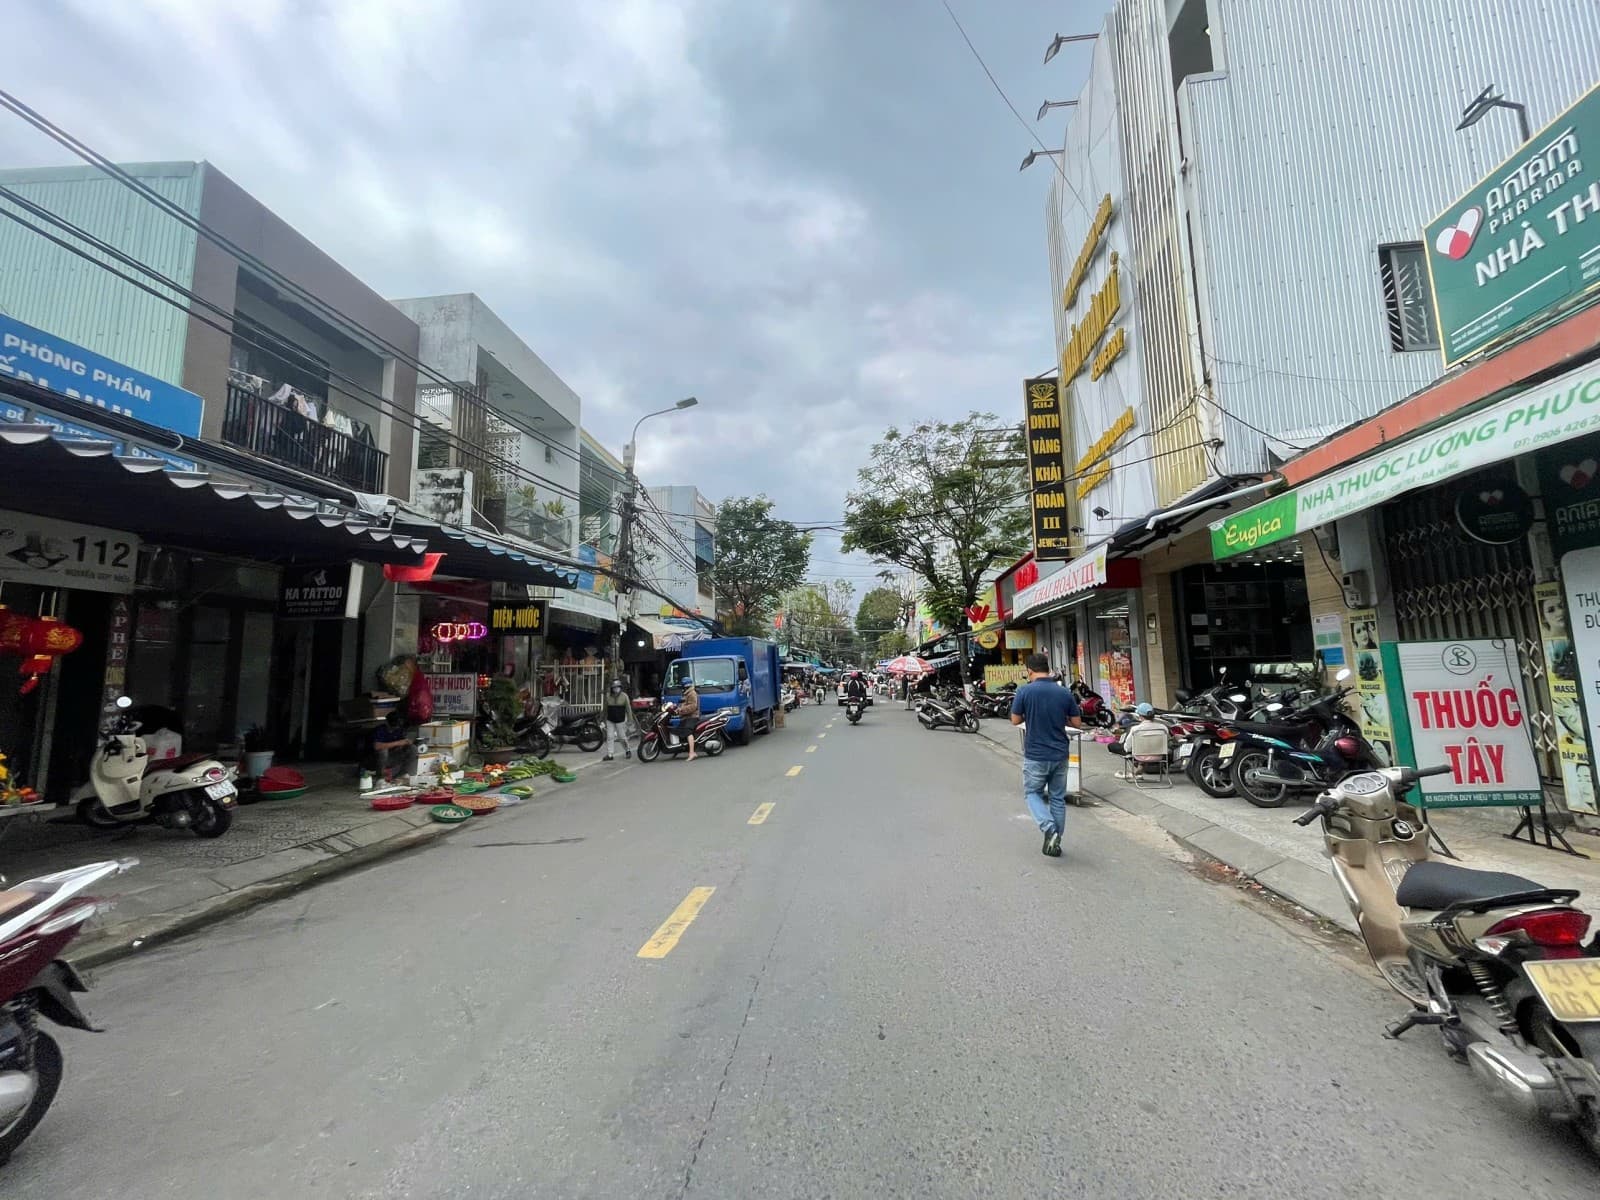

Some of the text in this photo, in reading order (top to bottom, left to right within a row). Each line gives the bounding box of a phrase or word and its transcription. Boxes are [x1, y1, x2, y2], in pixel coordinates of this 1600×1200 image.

[1490, 159, 1582, 235] PHARMA
[1475, 220, 1546, 287] NHÀ
[4, 333, 88, 376] PHÒNG
[1030, 413, 1060, 430] DNTN
[1032, 436, 1061, 455] VÀNG
[1035, 461, 1062, 482] KHẢI
[1302, 483, 1335, 513] NHÀ
[1337, 456, 1404, 497] THUỐC
[1406, 418, 1498, 471] LƯƠNG
[1036, 490, 1065, 509] HOÀN
[1043, 516, 1061, 530] III
[1225, 517, 1282, 546] Eugica
[72, 536, 130, 568] 112
[1081, 562, 1096, 584] III
[302, 586, 343, 600] TATTOO
[987, 670, 1006, 681] THAY
[1412, 675, 1522, 729] THUỐC
[1444, 737, 1504, 784] TÂY
